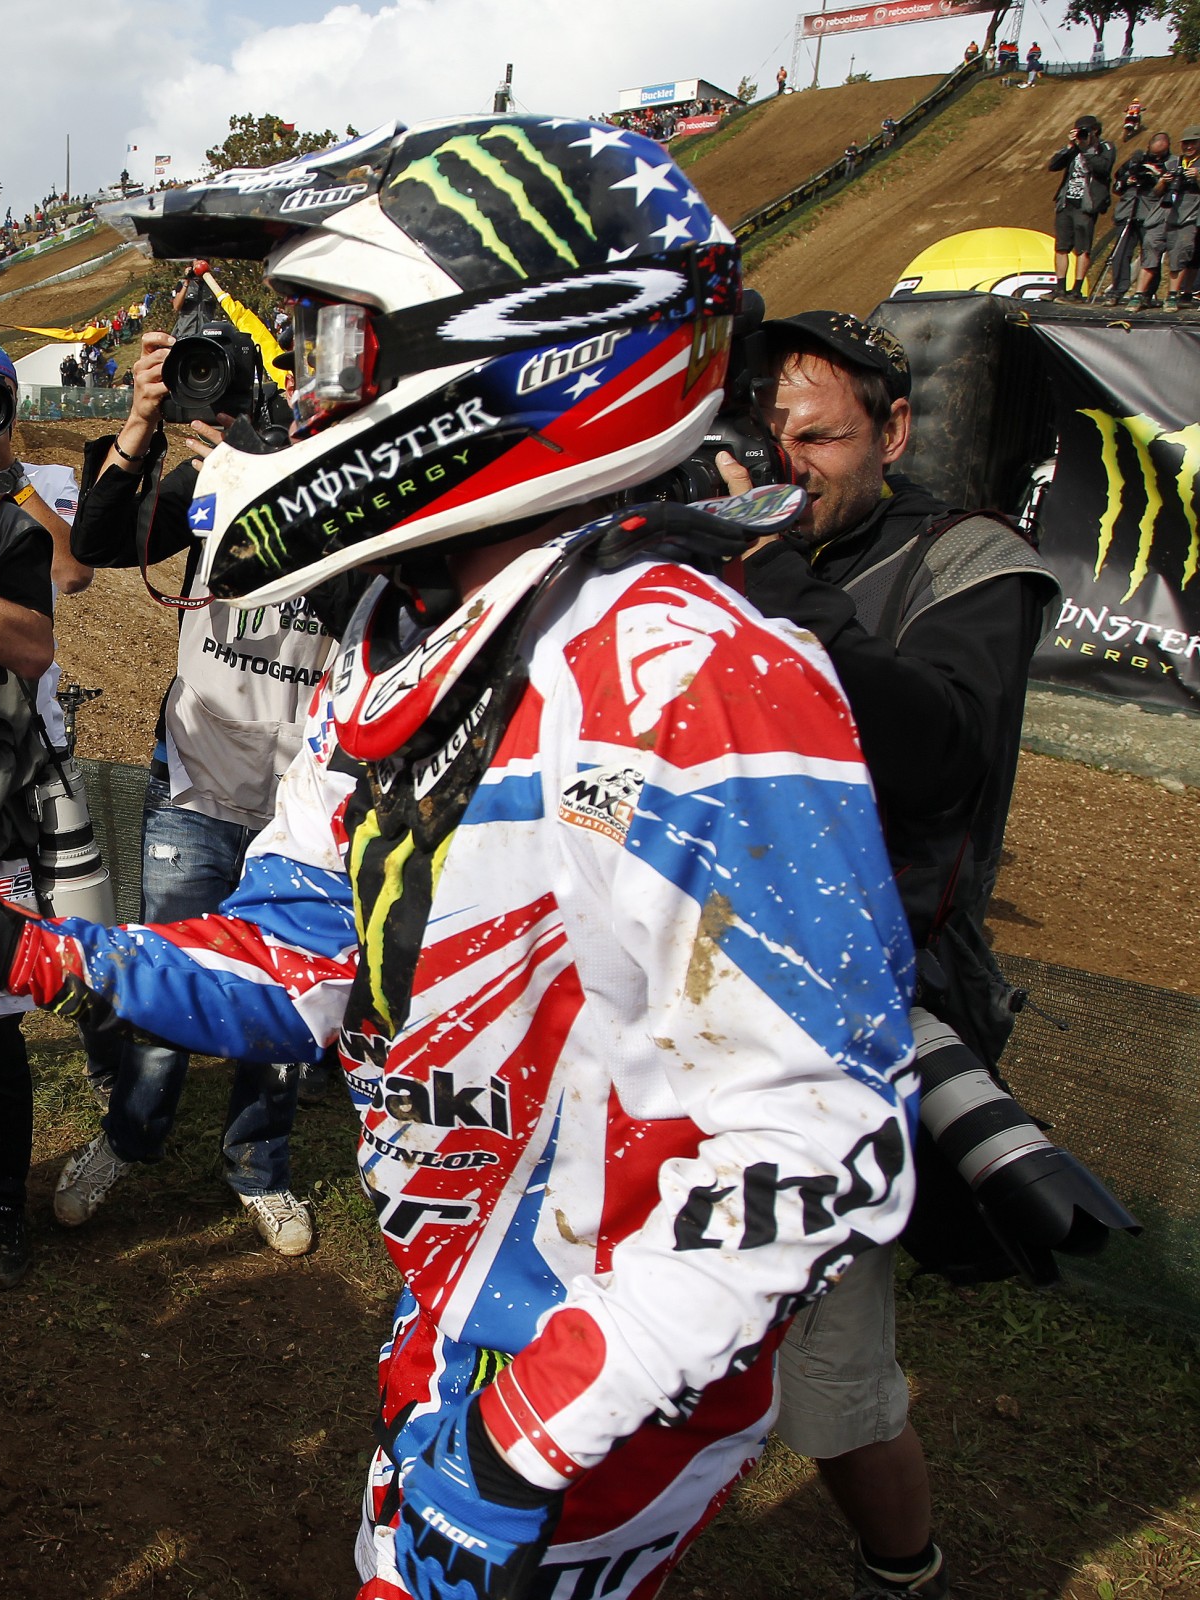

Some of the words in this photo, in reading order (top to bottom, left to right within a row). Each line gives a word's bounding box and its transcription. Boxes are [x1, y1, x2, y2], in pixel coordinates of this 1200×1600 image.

[826, 13, 868, 26] rebootizer
[889, 4, 933, 17] rebootizer
[641, 88, 674, 101] Buckler
[280, 184, 368, 214] thor
[516, 328, 632, 395] thor
[278, 396, 501, 522] MONSTER
[321, 448, 470, 536] ENERGY
[161, 596, 204, 606] Canon
[1055, 598, 1200, 658] ONSTER
[202, 636, 330, 688] PHOTOGRAP
[1054, 635, 1173, 674] NERGY
[575, 814, 626, 845] NATIONS
[363, 1128, 498, 1170] DUNLOP
[421, 1505, 488, 1550] thor
